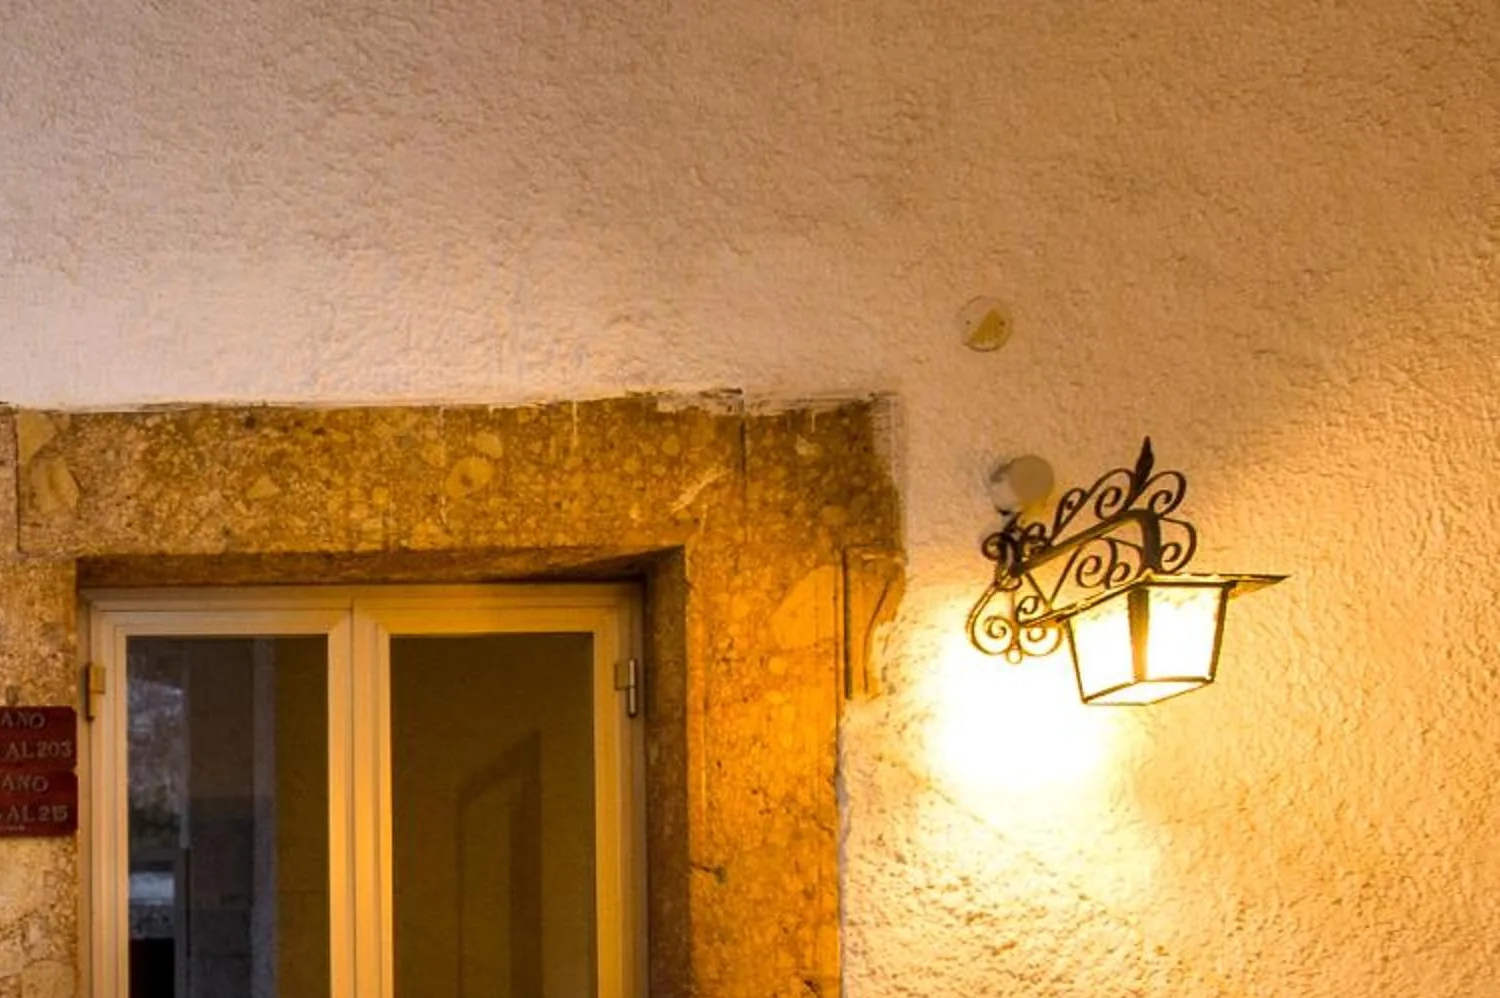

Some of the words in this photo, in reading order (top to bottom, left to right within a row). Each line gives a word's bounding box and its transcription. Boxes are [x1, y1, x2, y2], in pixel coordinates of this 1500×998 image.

[3, 741, 35, 760] AL
[36, 740, 73, 759] 203
[6, 804, 36, 824] AL
